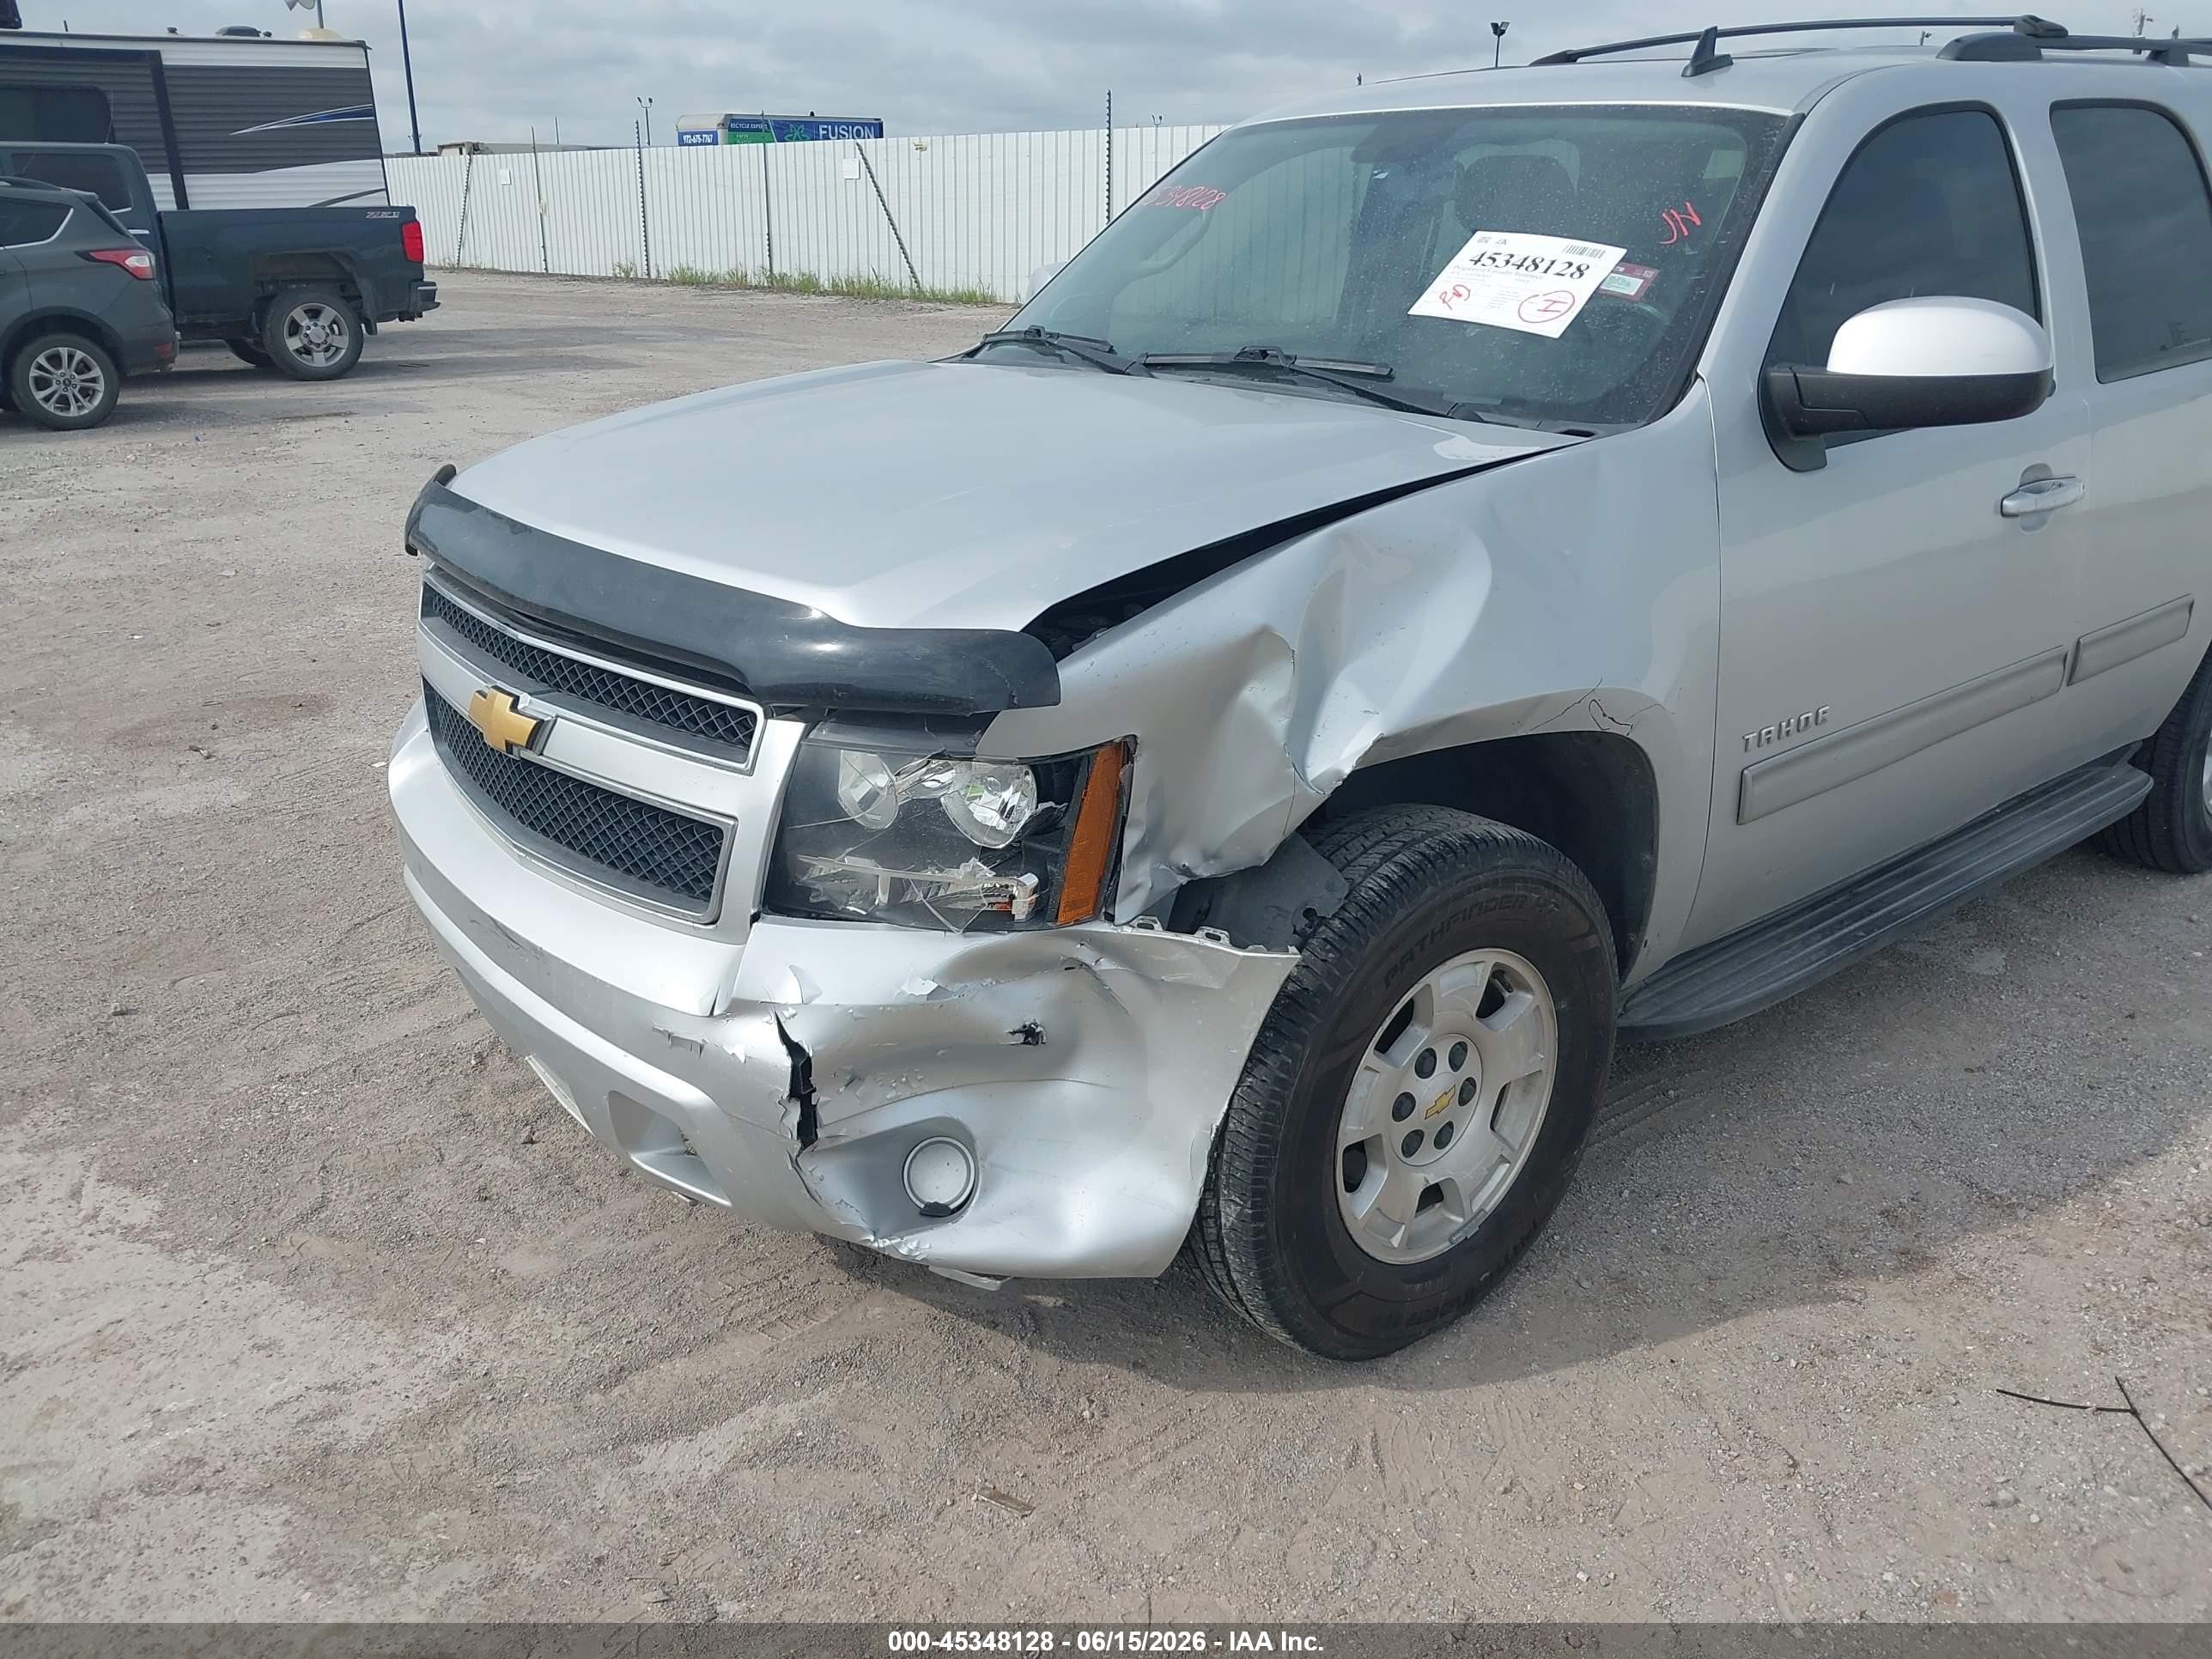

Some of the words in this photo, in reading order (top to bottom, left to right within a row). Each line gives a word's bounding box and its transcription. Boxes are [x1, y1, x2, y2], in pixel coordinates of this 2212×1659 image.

[818, 124, 875, 140] FUSION
[1469, 251, 1590, 279] 45348128
[1742, 704, 1830, 752] TAHOE
[1382, 893, 1529, 989] PATHFINDER
